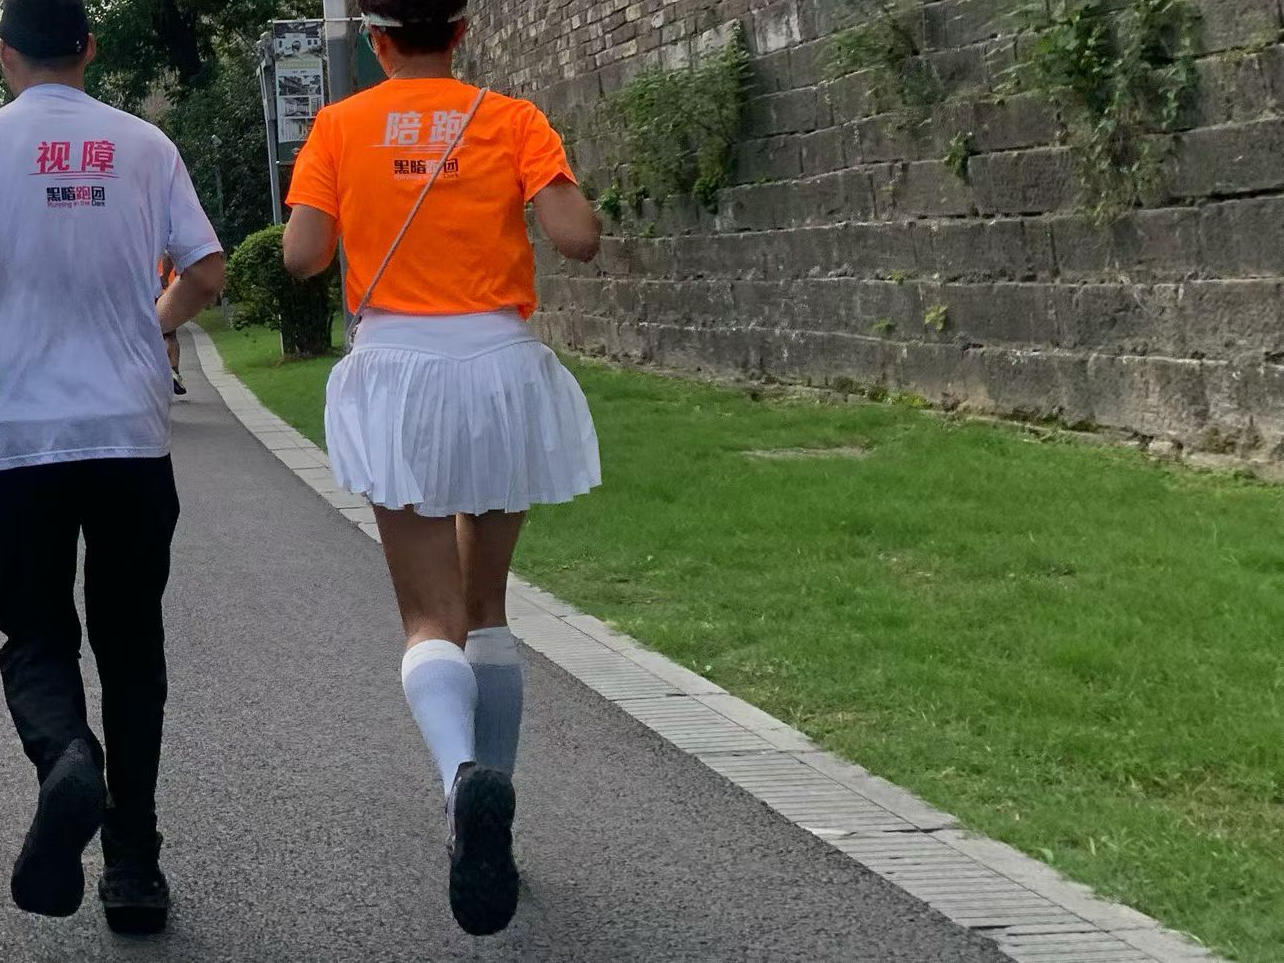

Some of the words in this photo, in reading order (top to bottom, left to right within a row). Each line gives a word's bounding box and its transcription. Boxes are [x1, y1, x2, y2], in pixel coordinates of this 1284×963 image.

[384, 110, 469, 146] 陪跑
[36, 141, 115, 173] 视障
[46, 186, 105, 201] 黑暗跑团
